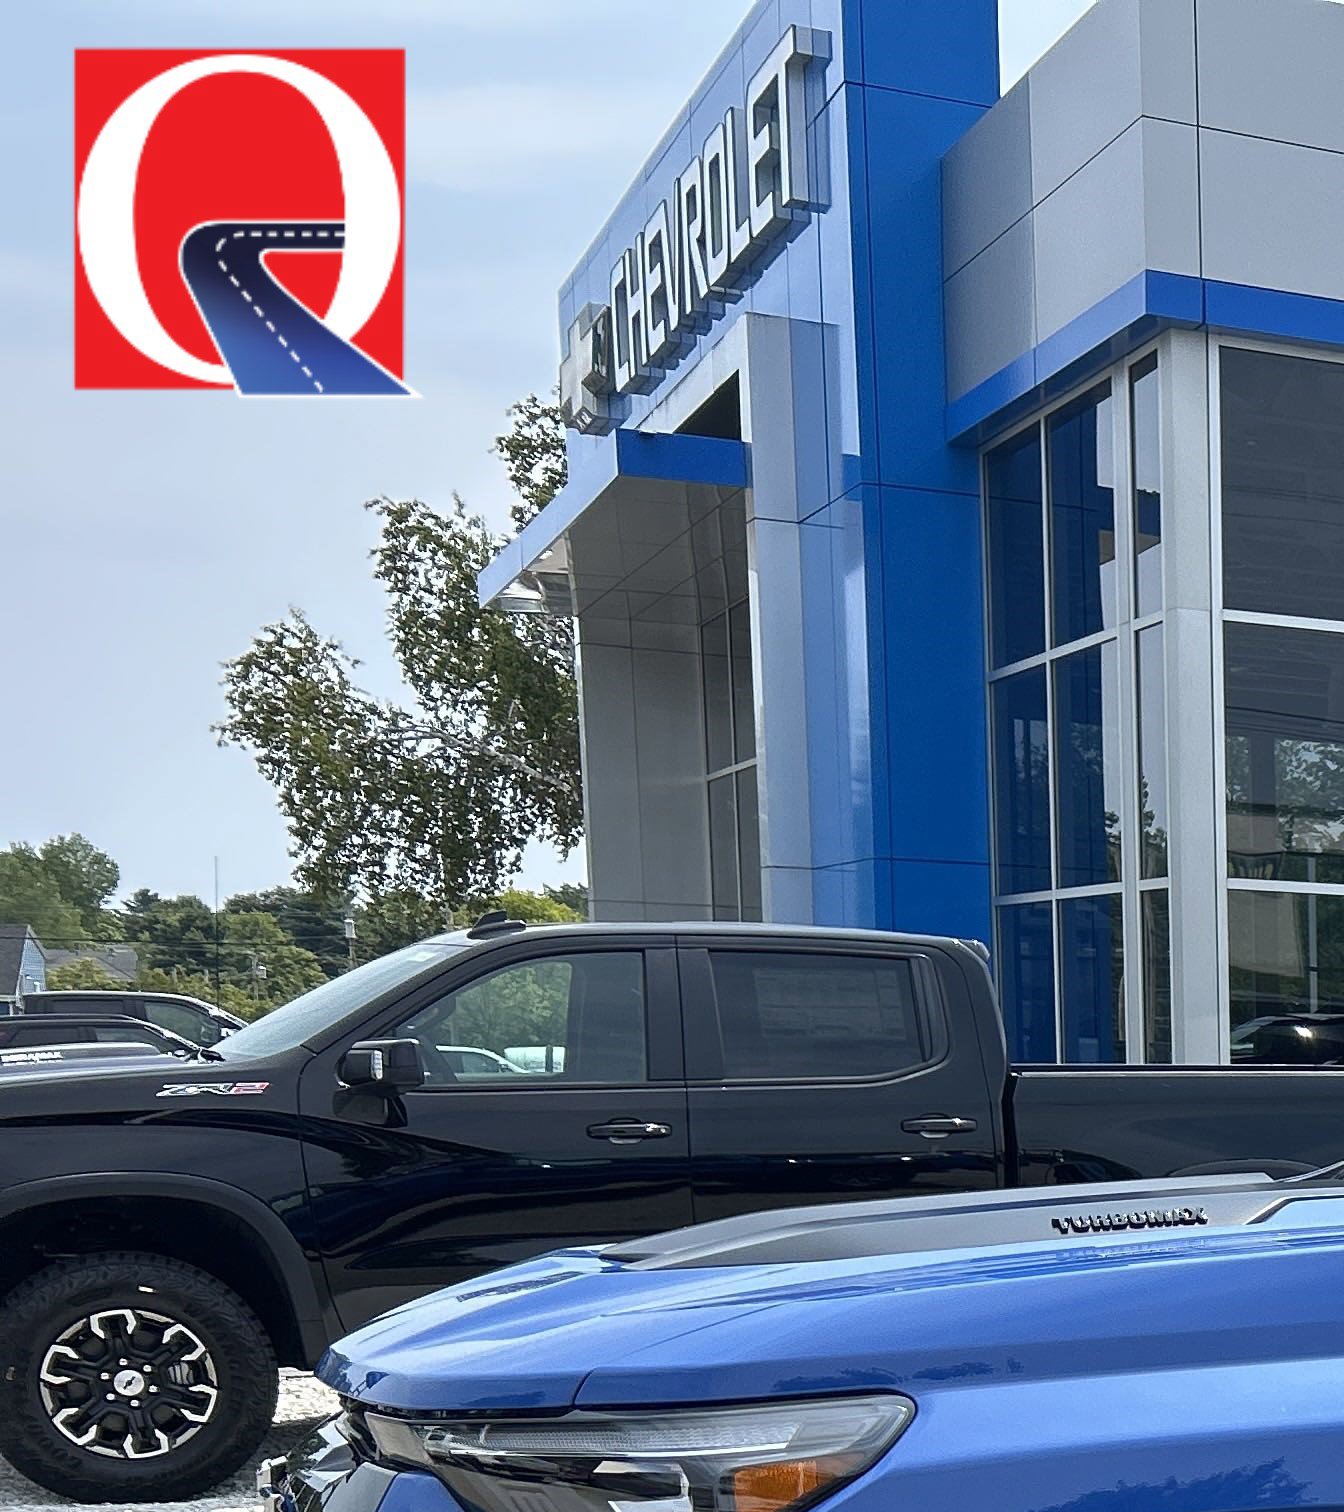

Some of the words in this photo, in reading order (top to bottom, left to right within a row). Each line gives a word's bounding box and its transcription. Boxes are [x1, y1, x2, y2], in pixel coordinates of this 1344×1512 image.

[609, 24, 832, 396] CHEVROLET
[155, 1081, 270, 1097] ZR2
[1051, 1207, 1209, 1235] TURBOMAX
